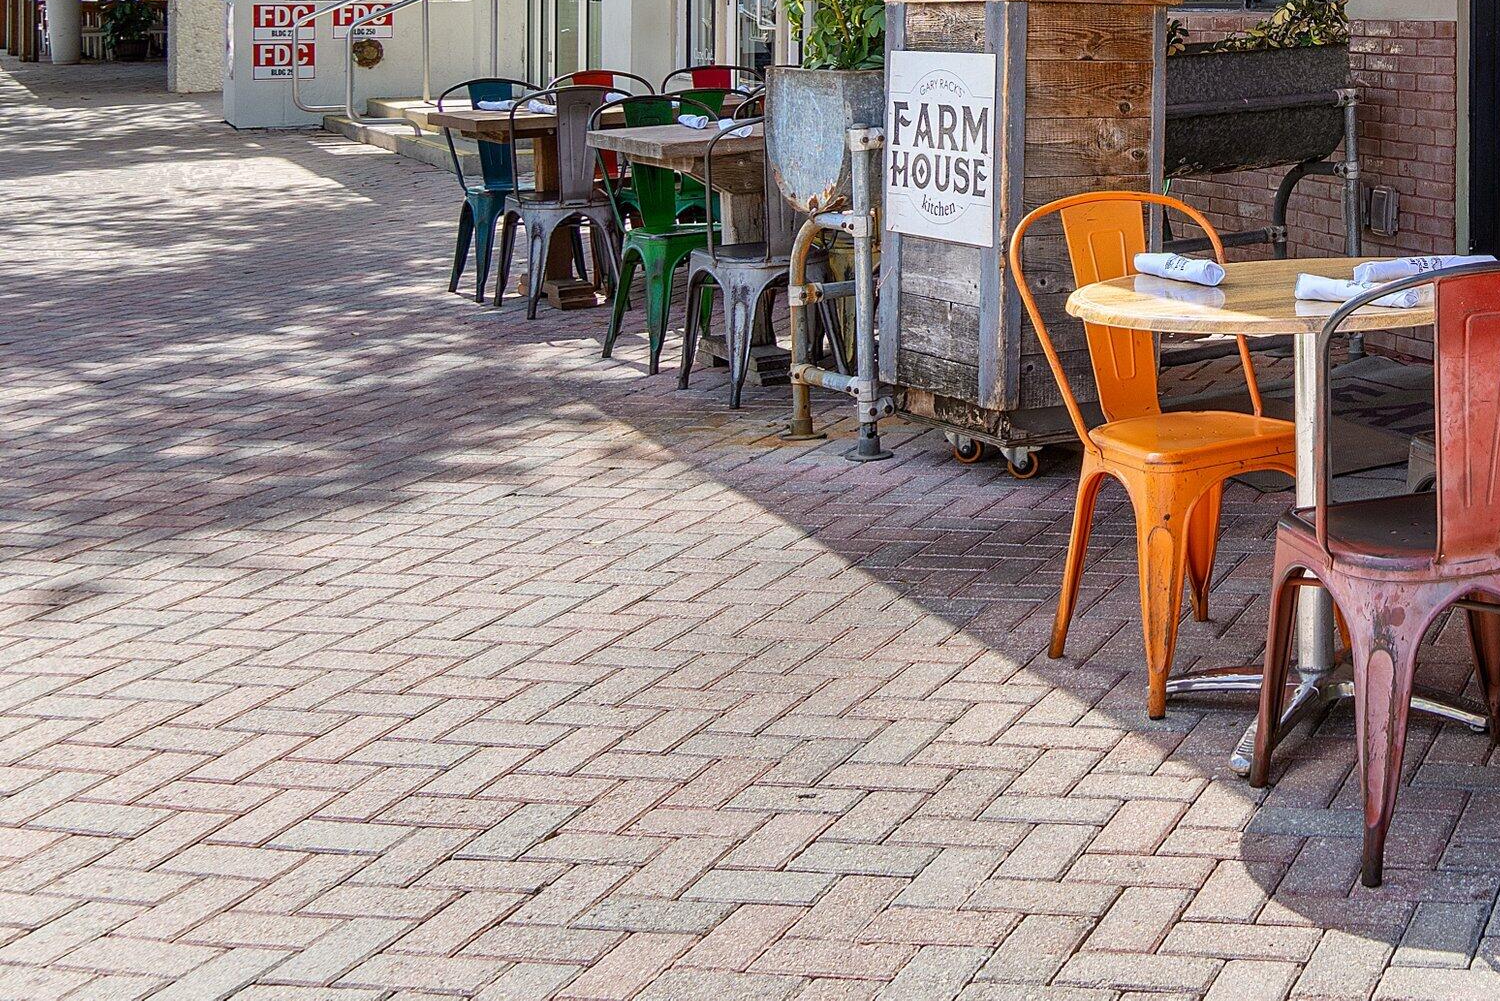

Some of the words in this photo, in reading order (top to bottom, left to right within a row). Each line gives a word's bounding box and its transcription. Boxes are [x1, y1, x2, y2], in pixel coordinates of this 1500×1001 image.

[259, 5, 309, 27] FDC
[339, 4, 387, 25] FDC
[259, 45, 309, 66] FDC
[919, 80, 938, 96] GARY
[892, 101, 989, 154] FARM
[890, 150, 988, 198] HOUSE
[921, 194, 956, 217] kitchen
